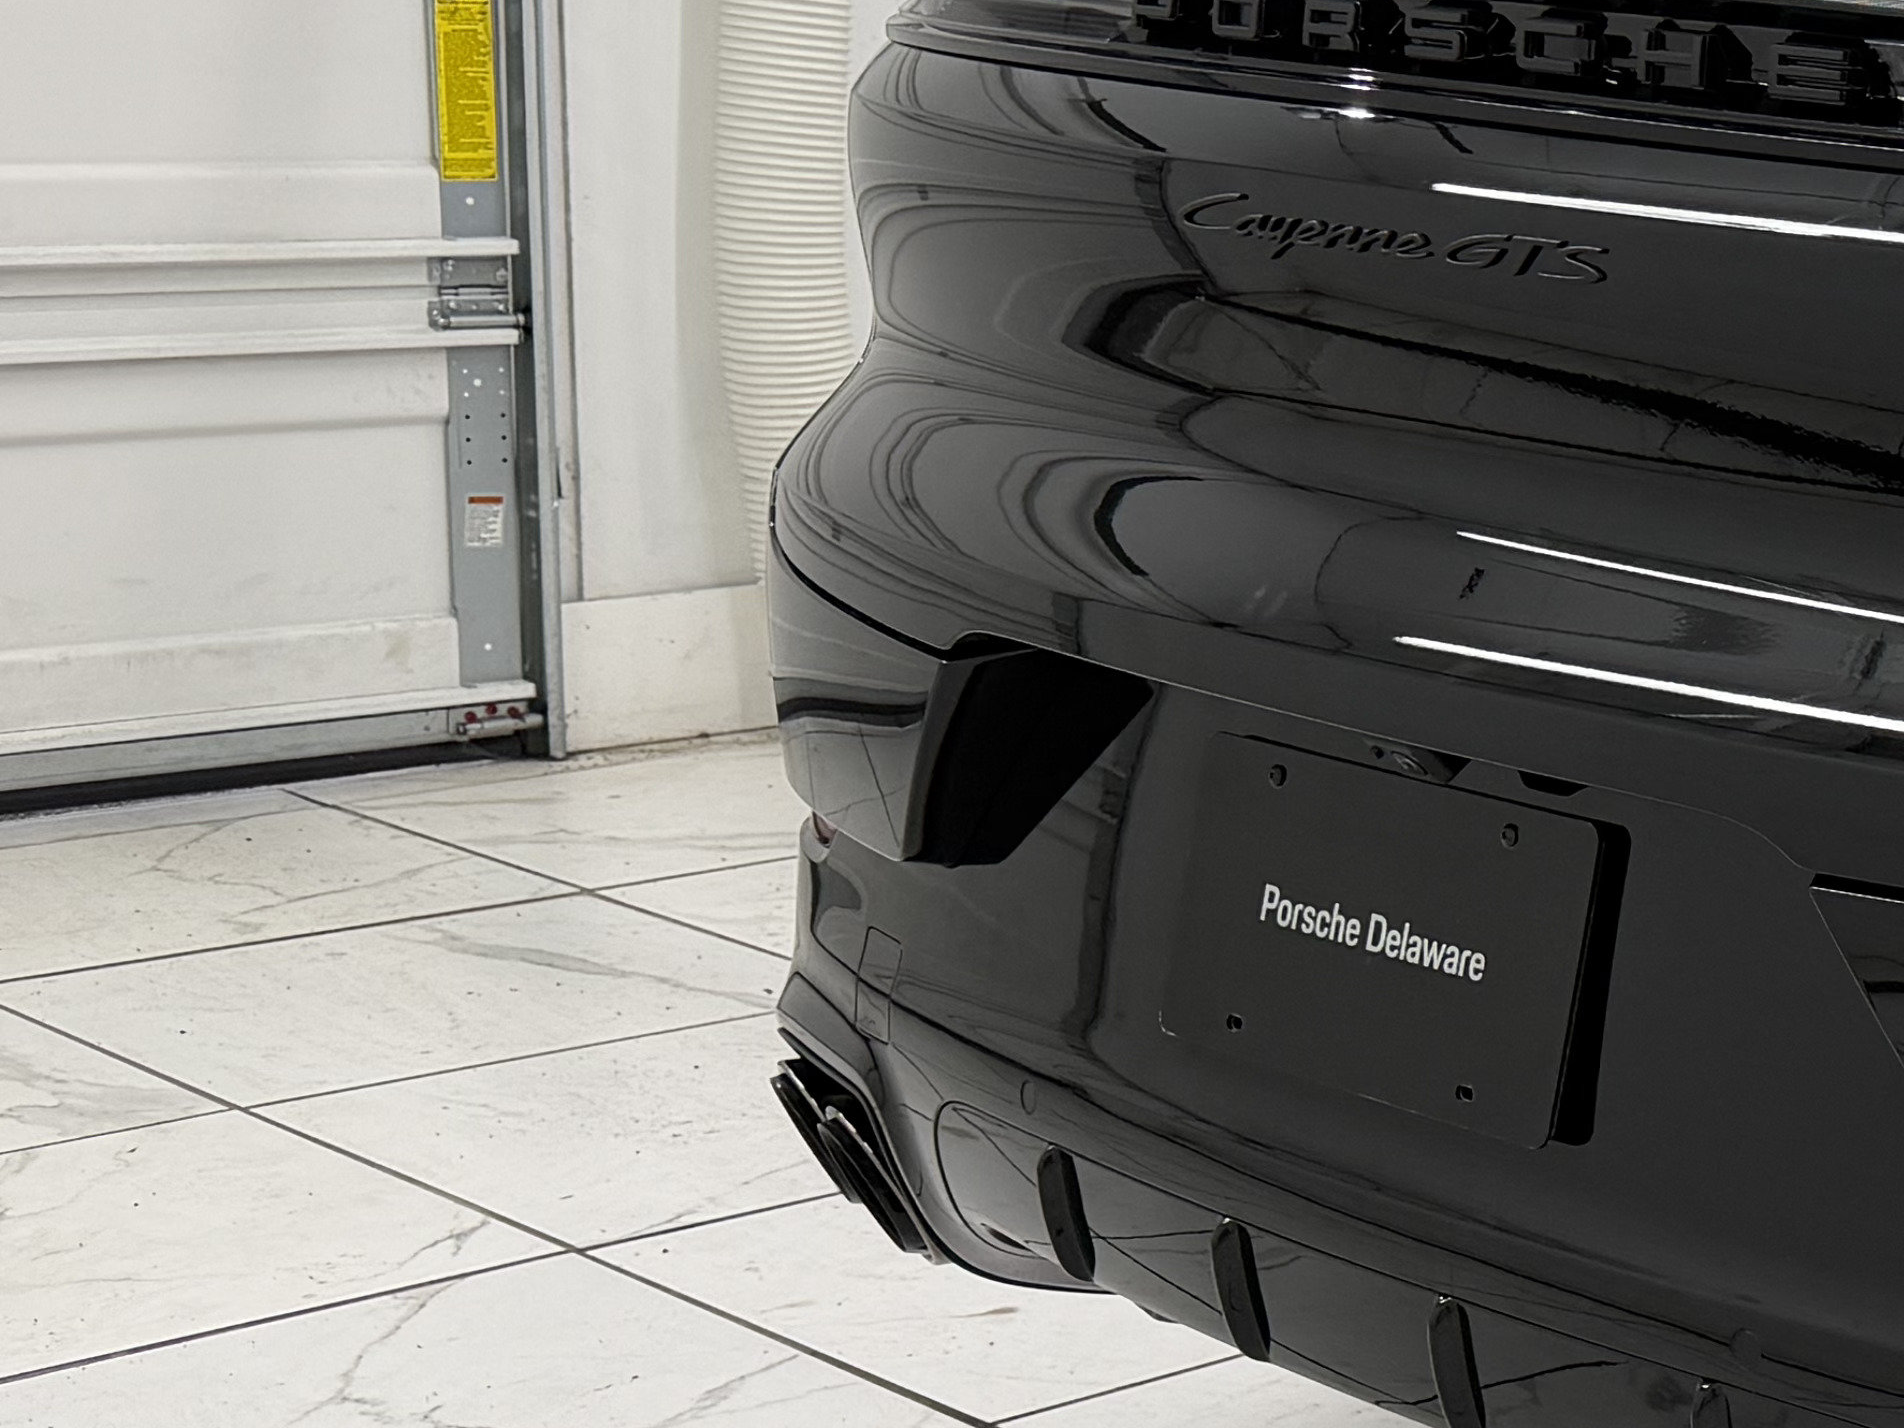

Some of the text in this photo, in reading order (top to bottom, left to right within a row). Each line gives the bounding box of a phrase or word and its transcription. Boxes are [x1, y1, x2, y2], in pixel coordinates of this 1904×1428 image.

[1178, 192, 1610, 284] Cayenne GTS
[1259, 883, 1486, 982] Porsche Delaware
